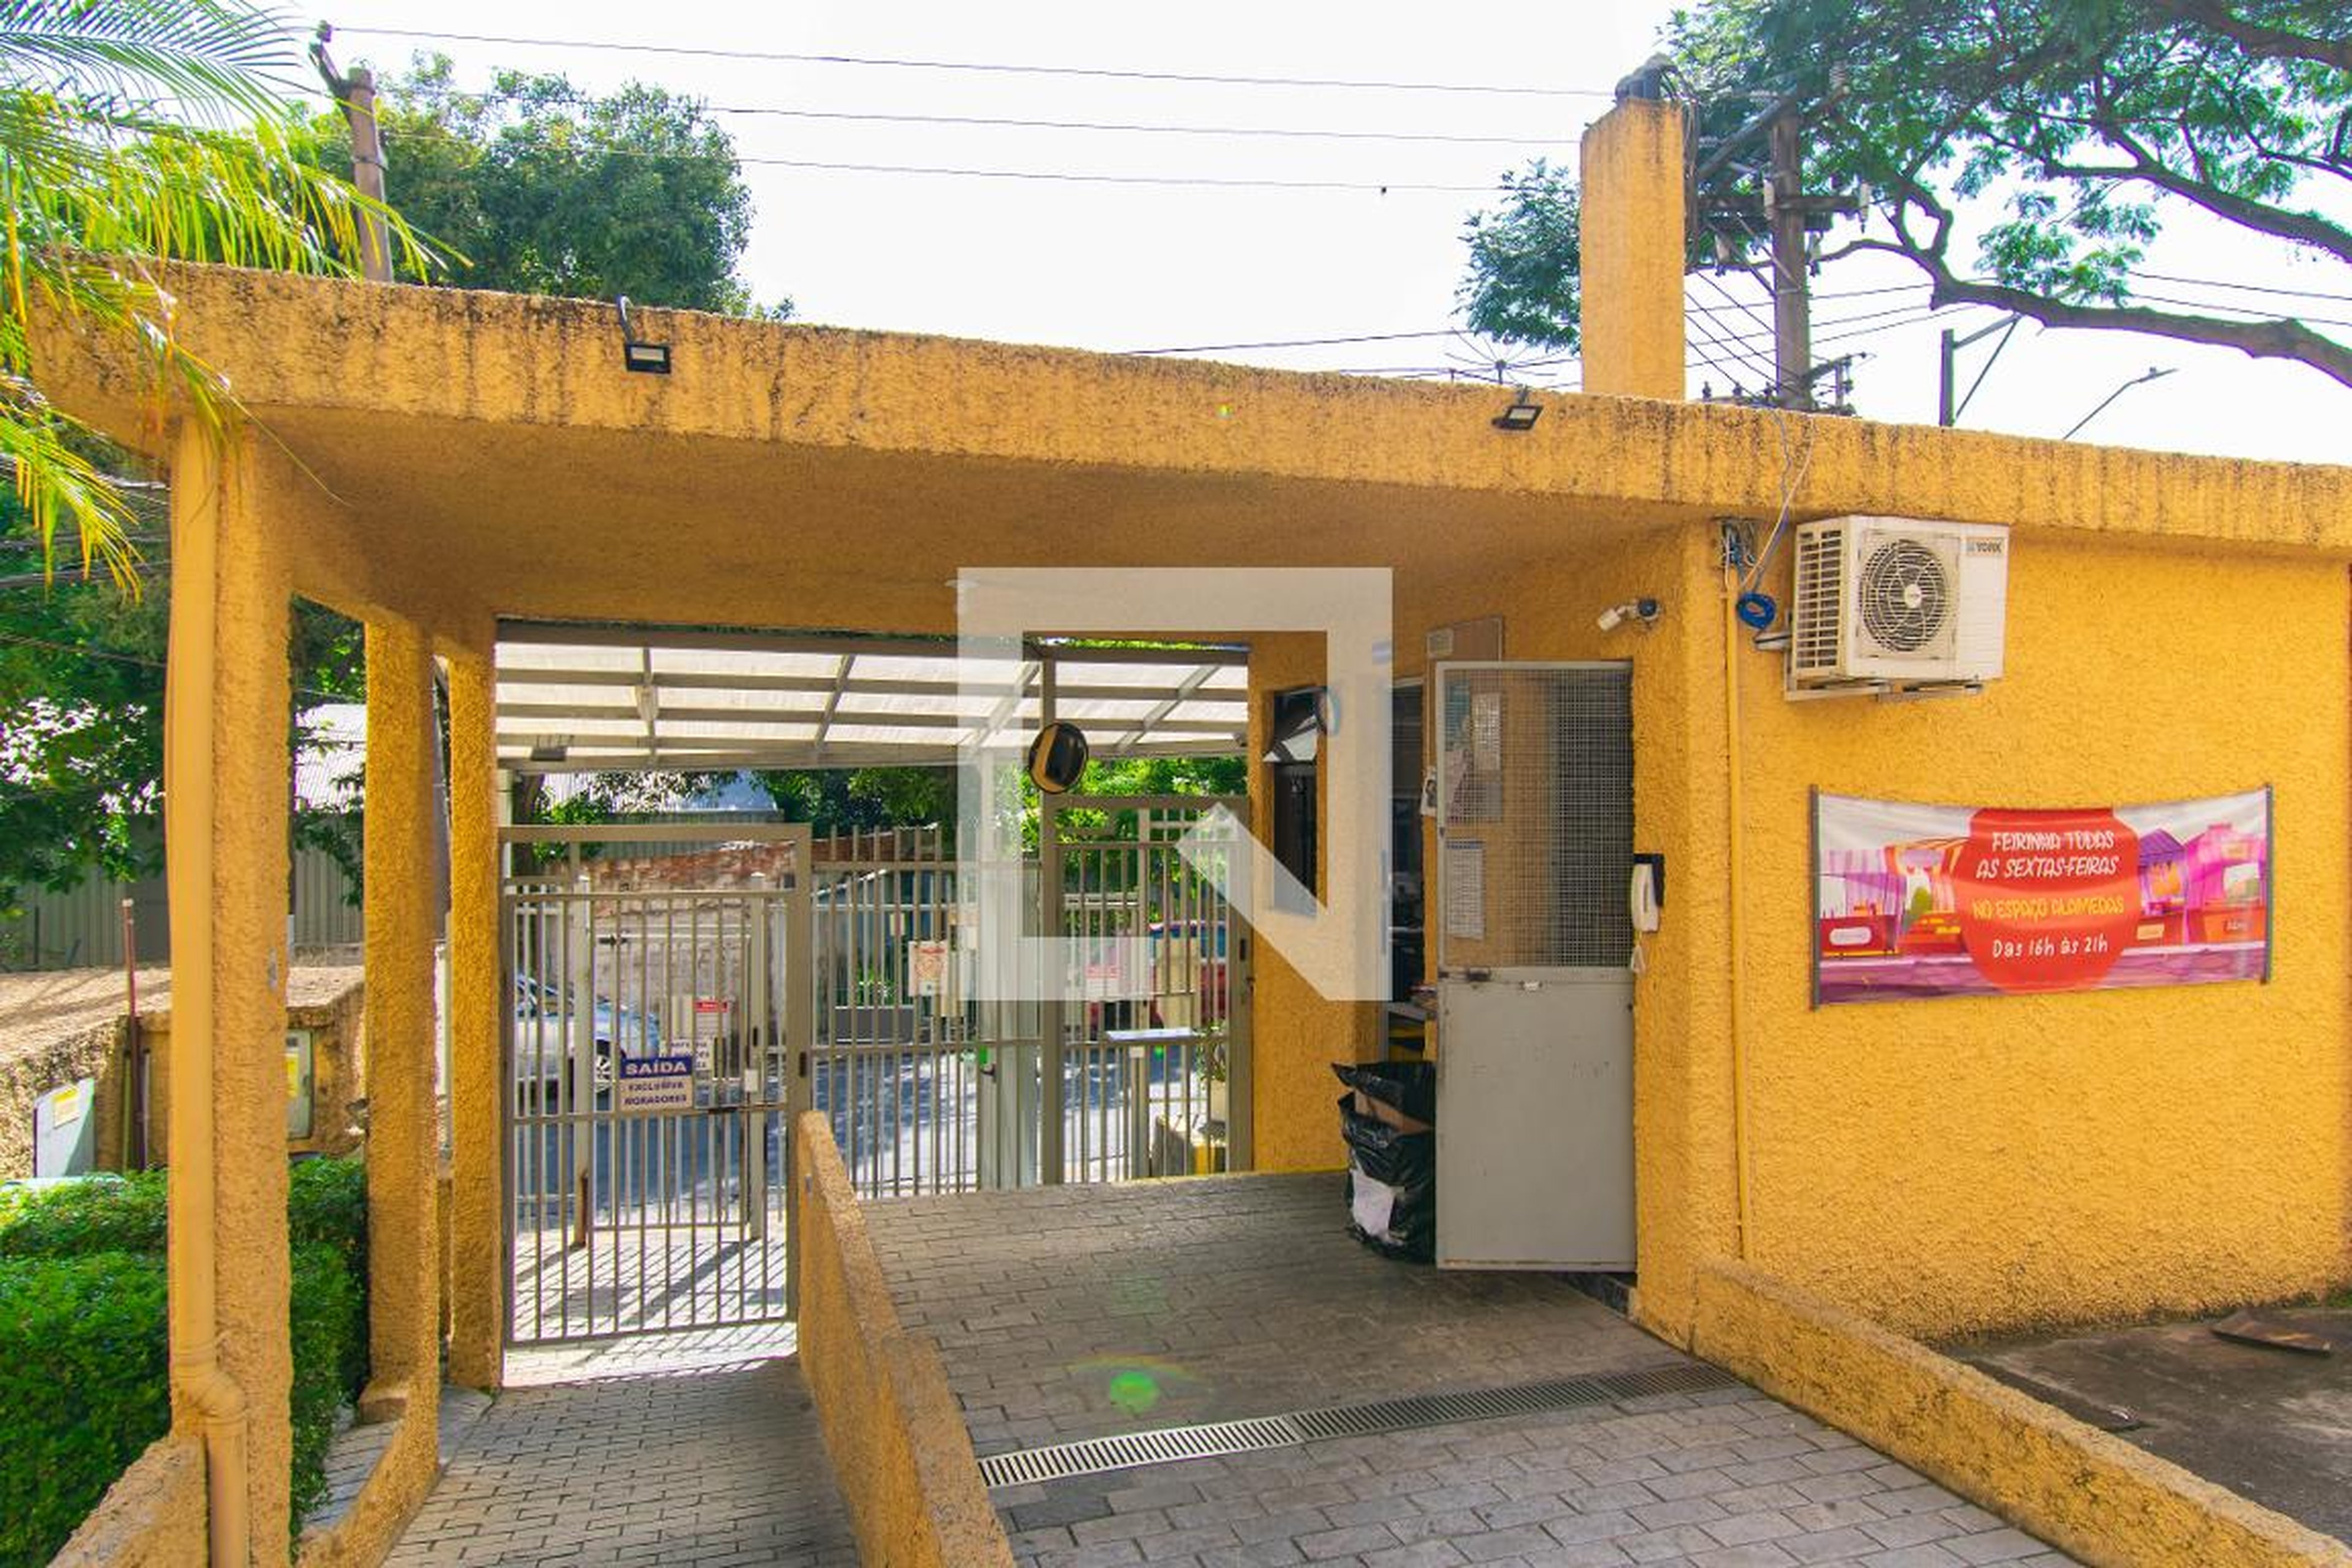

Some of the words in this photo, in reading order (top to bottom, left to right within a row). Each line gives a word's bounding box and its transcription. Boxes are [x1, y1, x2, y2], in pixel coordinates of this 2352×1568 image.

[1992, 832, 2060, 851] FEIRINHA
[2064, 830, 2114, 850] TODAS
[2004, 856, 2119, 878] SEXTAS-FEIRAS
[1972, 898, 1991, 919] NO
[1995, 897, 2048, 922] ESPAÇO
[1992, 938, 2022, 958] Das
[2029, 936, 2055, 956] 16h
[2060, 936, 2079, 954] às
[2084, 933, 2108, 953] 21h
[625, 1059, 687, 1075] SAÍDA
